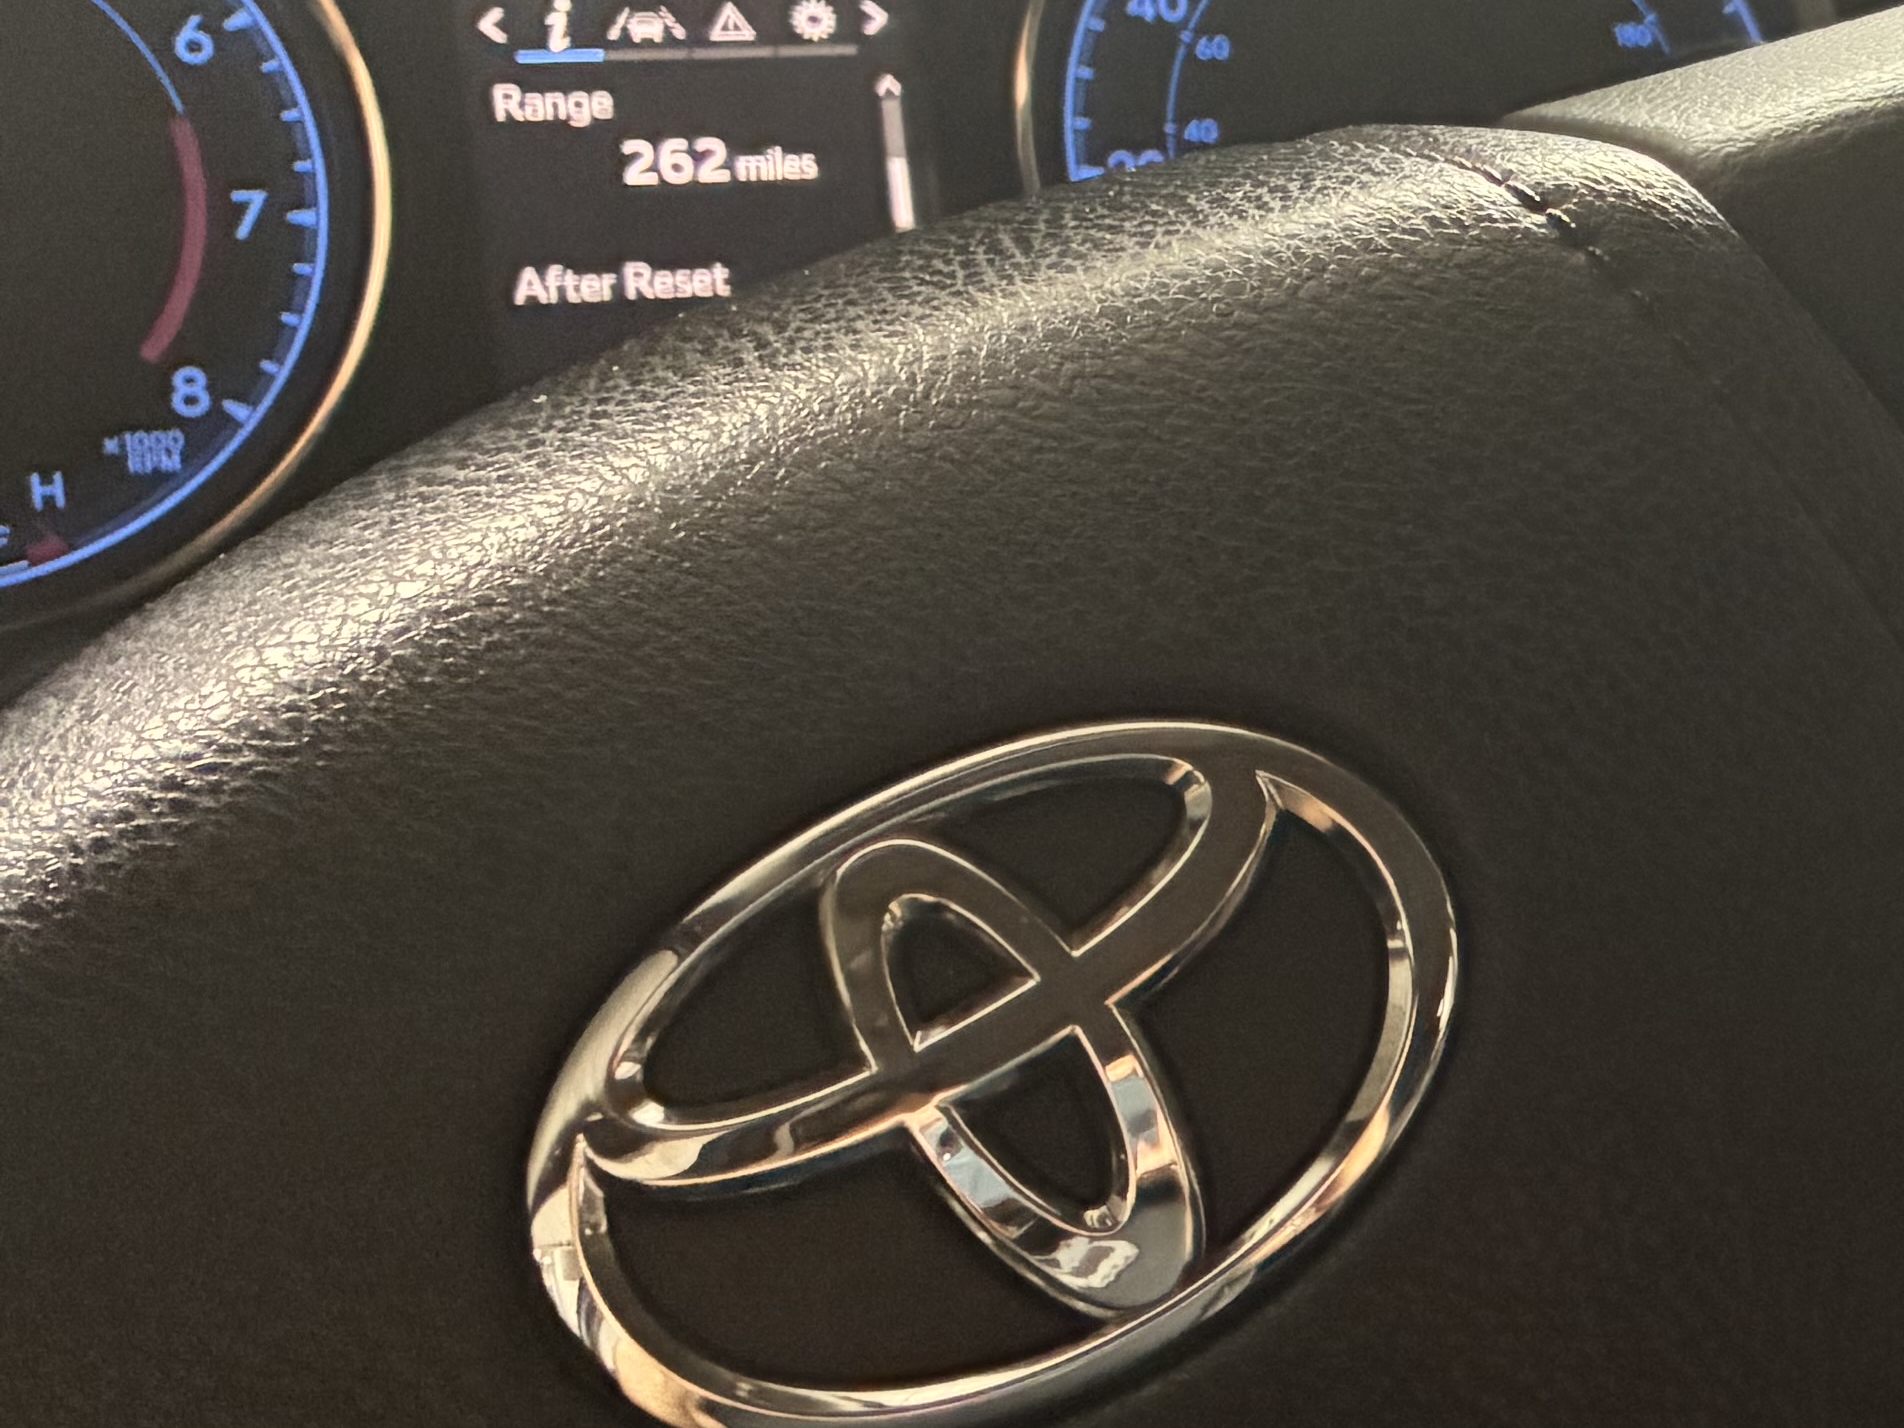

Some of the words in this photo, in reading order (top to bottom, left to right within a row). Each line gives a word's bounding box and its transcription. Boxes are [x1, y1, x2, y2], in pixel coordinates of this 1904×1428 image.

[174, 14, 215, 66] 6
[1195, 34, 1231, 61] 60
[492, 83, 615, 128] Range
[619, 136, 732, 186] 262
[734, 145, 819, 182] miles
[229, 189, 268, 241] 7
[513, 264, 618, 306] After
[621, 261, 732, 301] Reset
[170, 365, 212, 419] 8
[29, 471, 66, 512] H
